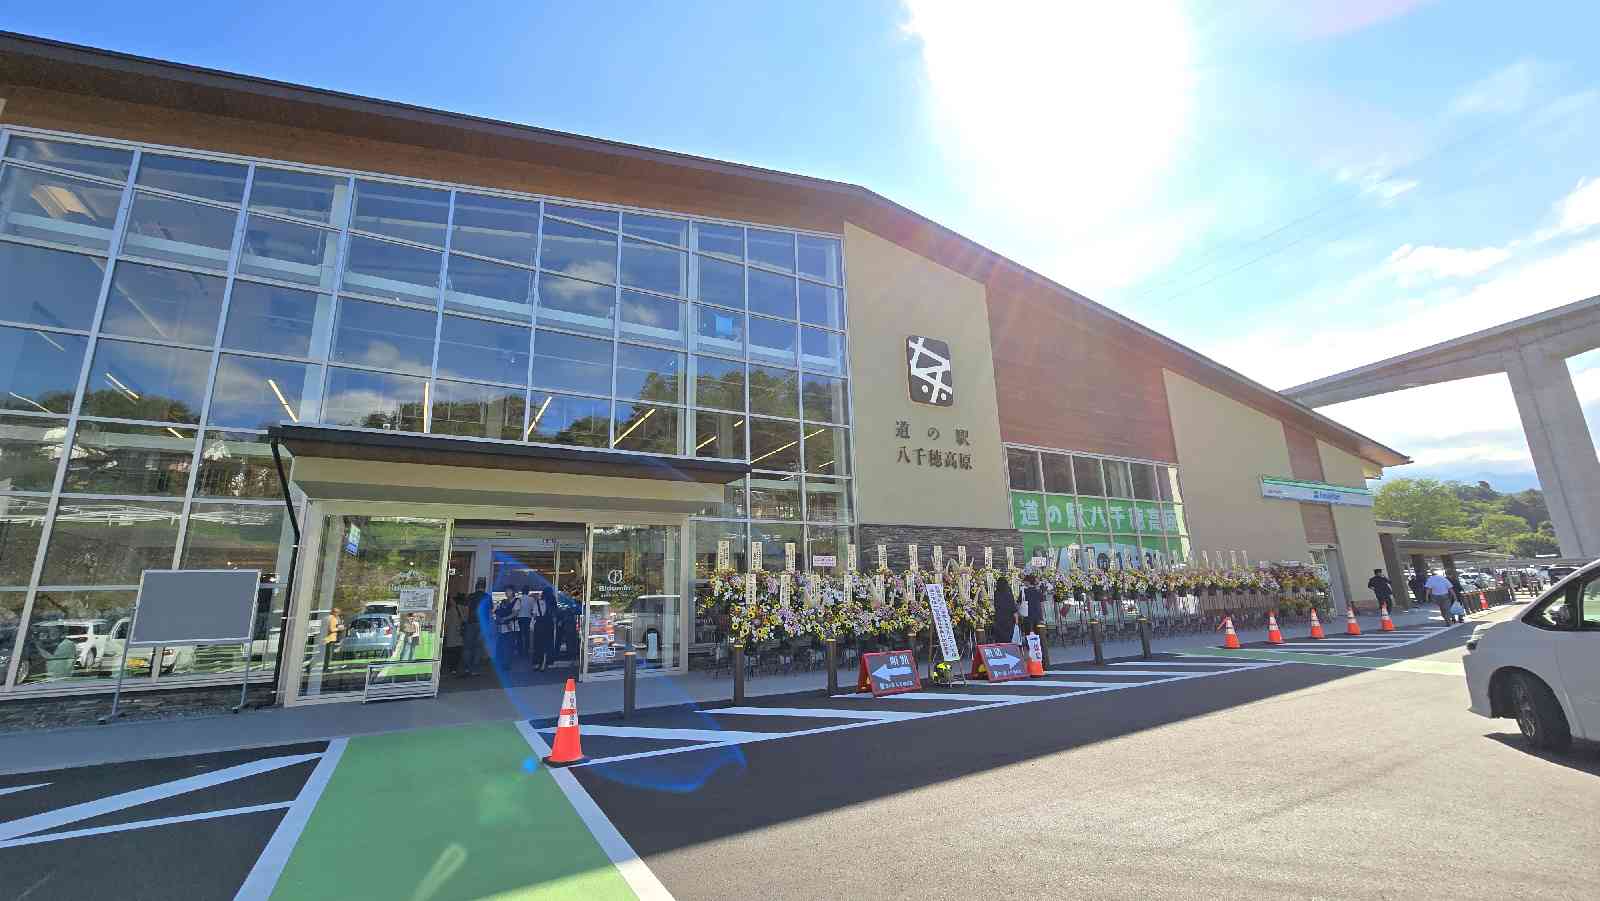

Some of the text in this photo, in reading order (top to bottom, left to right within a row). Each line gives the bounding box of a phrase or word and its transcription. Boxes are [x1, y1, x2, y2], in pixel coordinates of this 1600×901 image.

[896, 446, 973, 470] 八千穂高原
